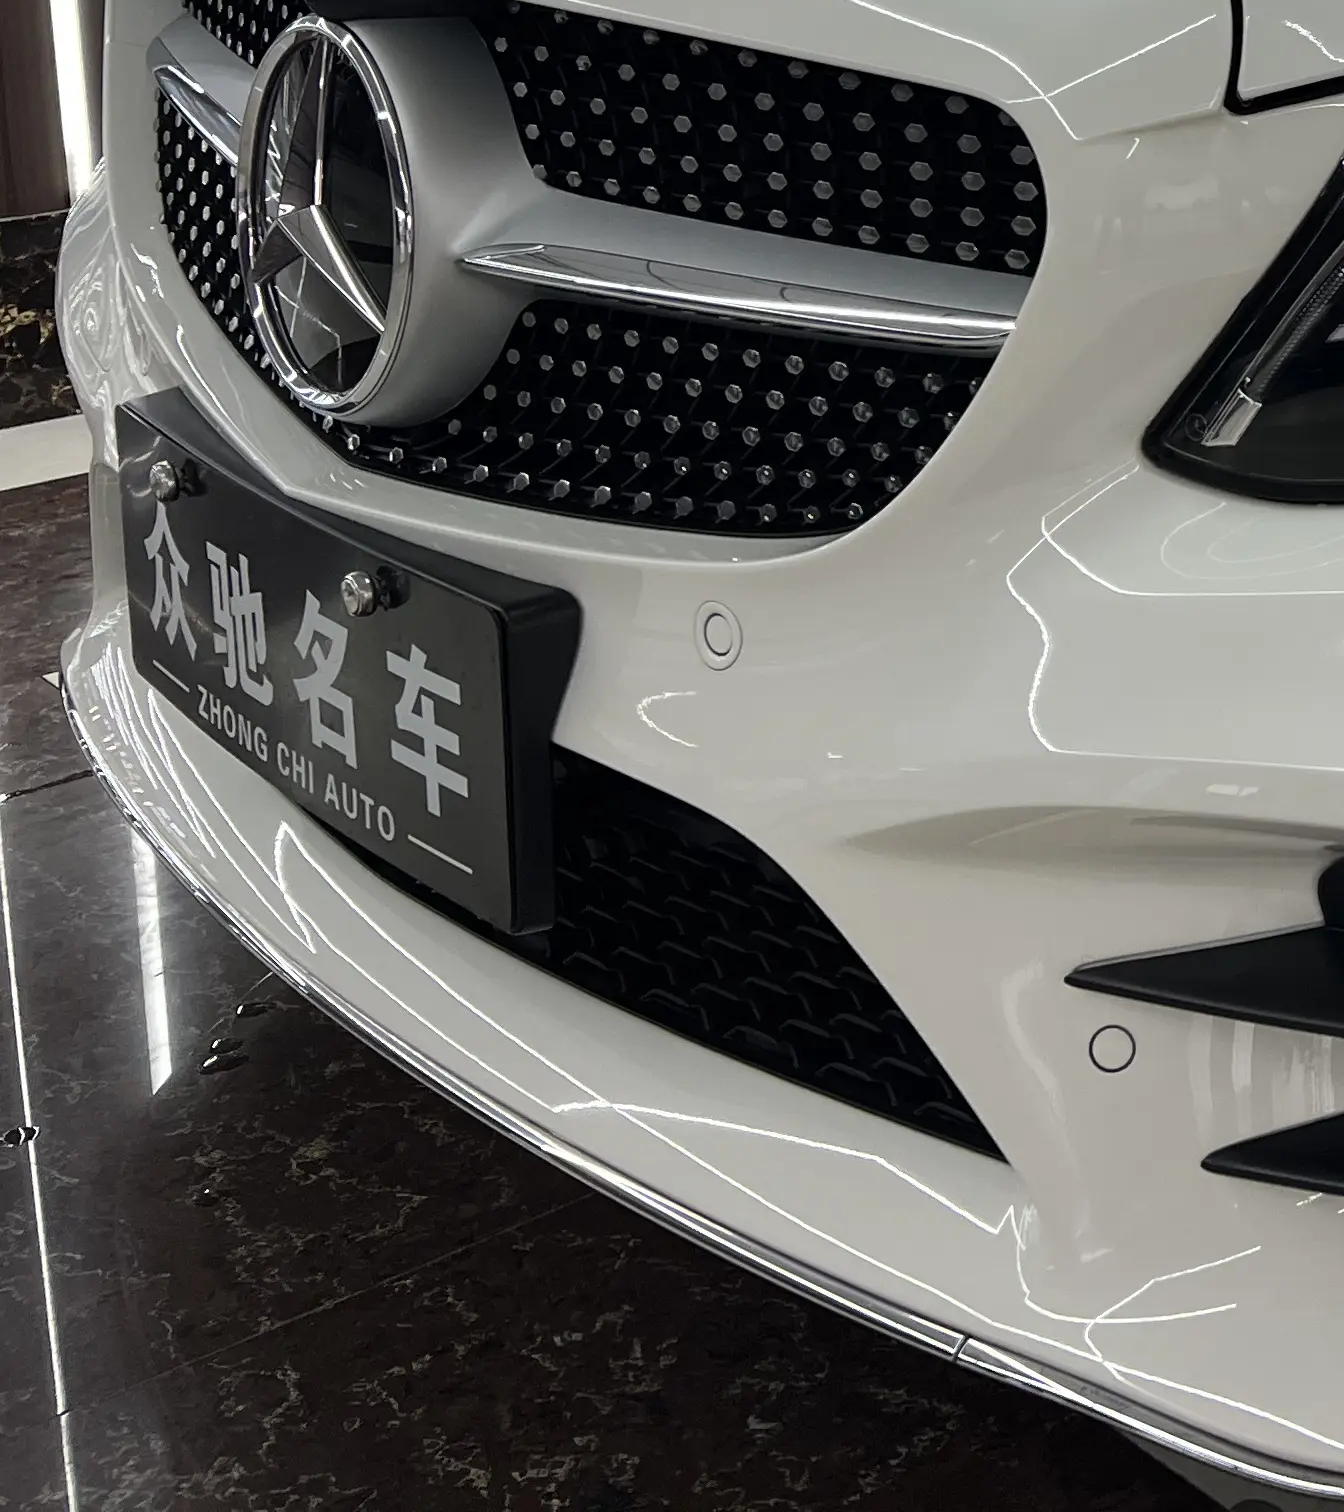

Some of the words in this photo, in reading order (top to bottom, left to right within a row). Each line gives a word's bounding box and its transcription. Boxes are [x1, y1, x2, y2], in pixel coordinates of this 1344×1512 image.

[143, 500, 470, 818] 众驰名车
[197, 684, 269, 763] ZHONG
[276, 741, 315, 794] CHI
[324, 772, 396, 842] AUTO
